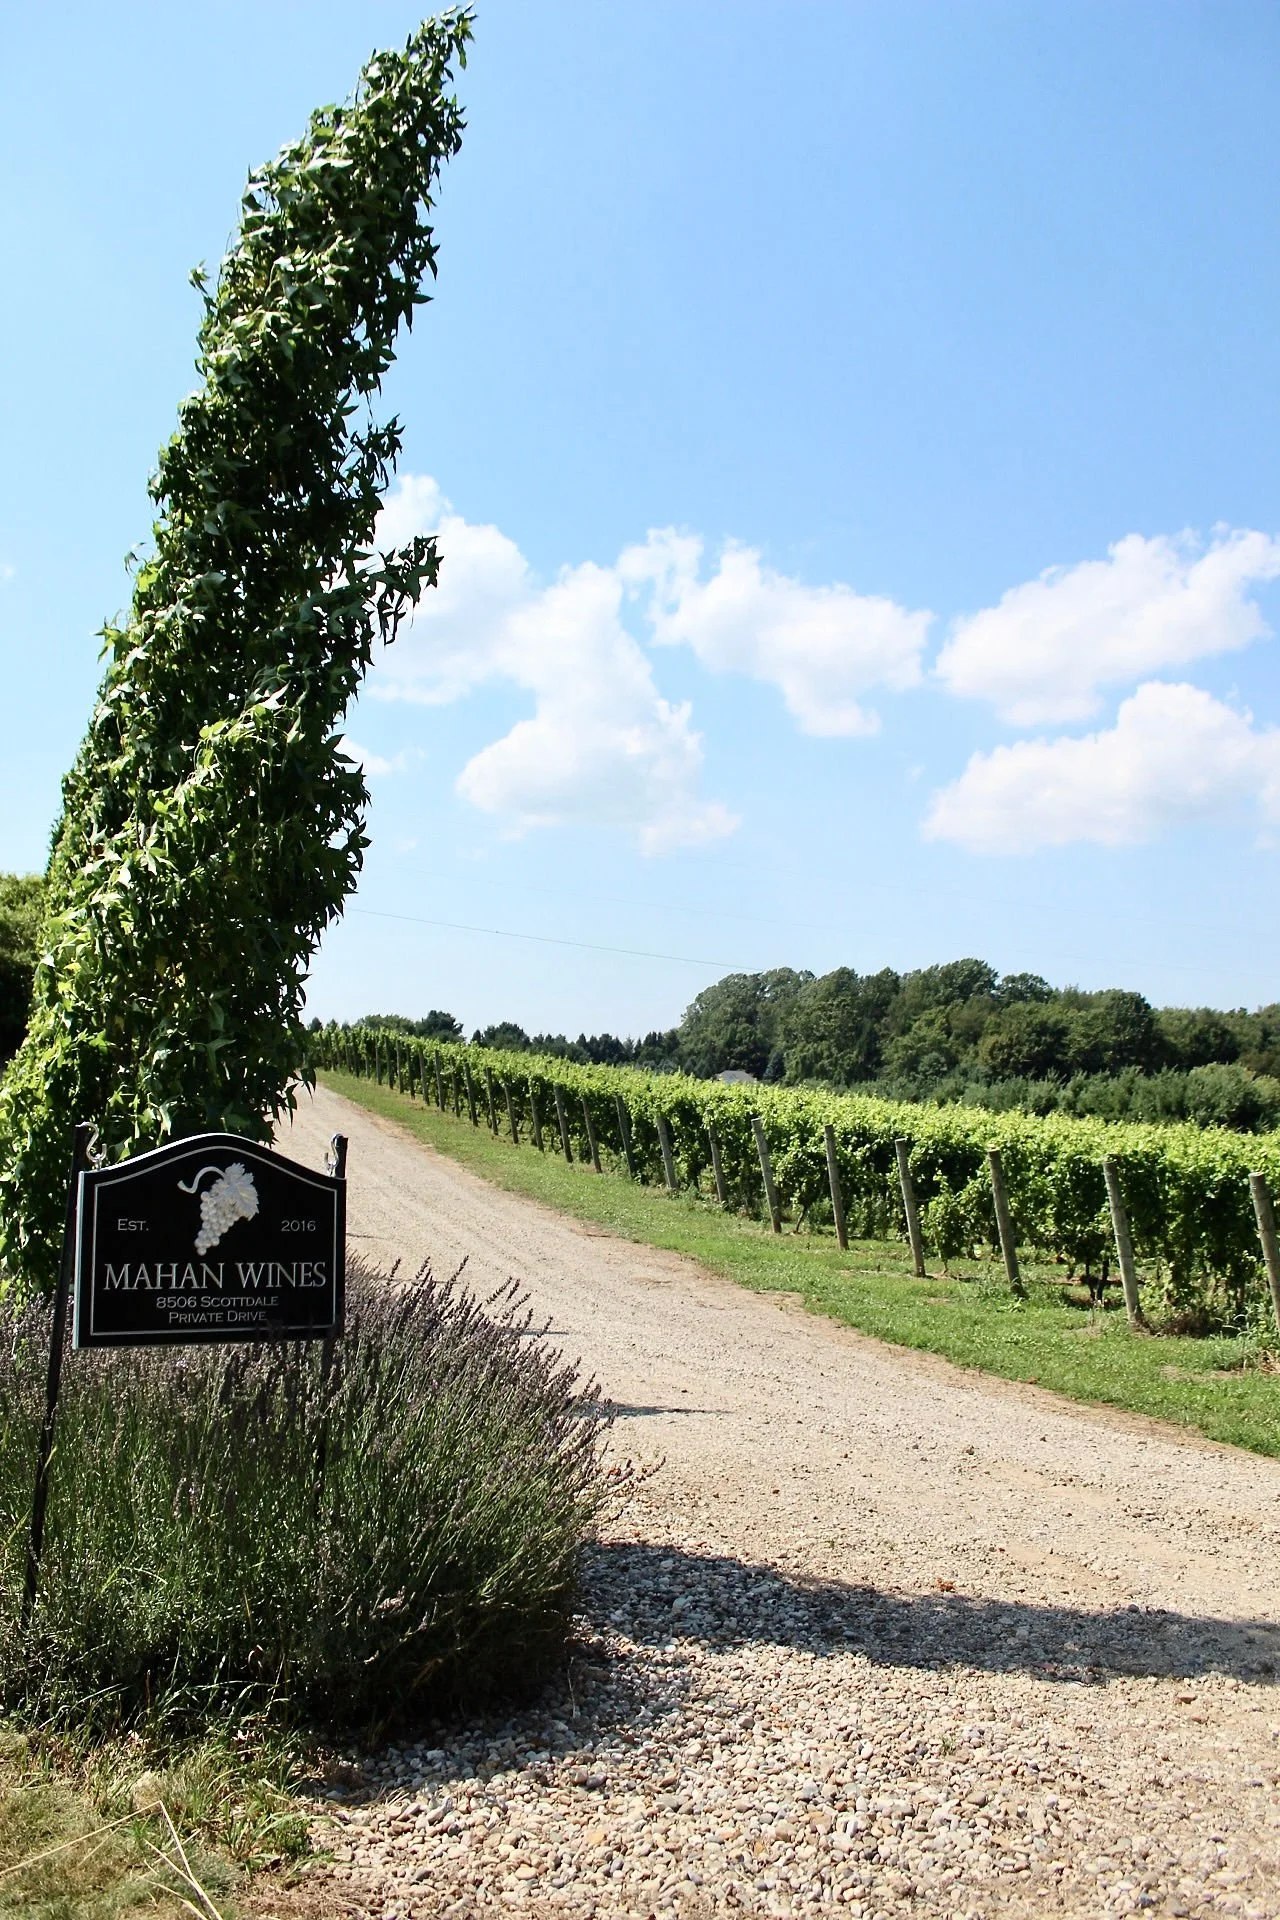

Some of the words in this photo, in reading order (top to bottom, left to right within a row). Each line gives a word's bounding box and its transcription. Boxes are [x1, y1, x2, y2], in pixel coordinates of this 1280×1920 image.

[281, 1219, 316, 1232] 2016
[103, 1261, 223, 1290] MAHAN
[235, 1261, 327, 1288] WINES
[156, 1296, 197, 1309] 8506
[200, 1296, 279, 1307] SCOTTDALE
[168, 1311, 224, 1323] PRIVATE
[227, 1310, 267, 1322] DRIVE
